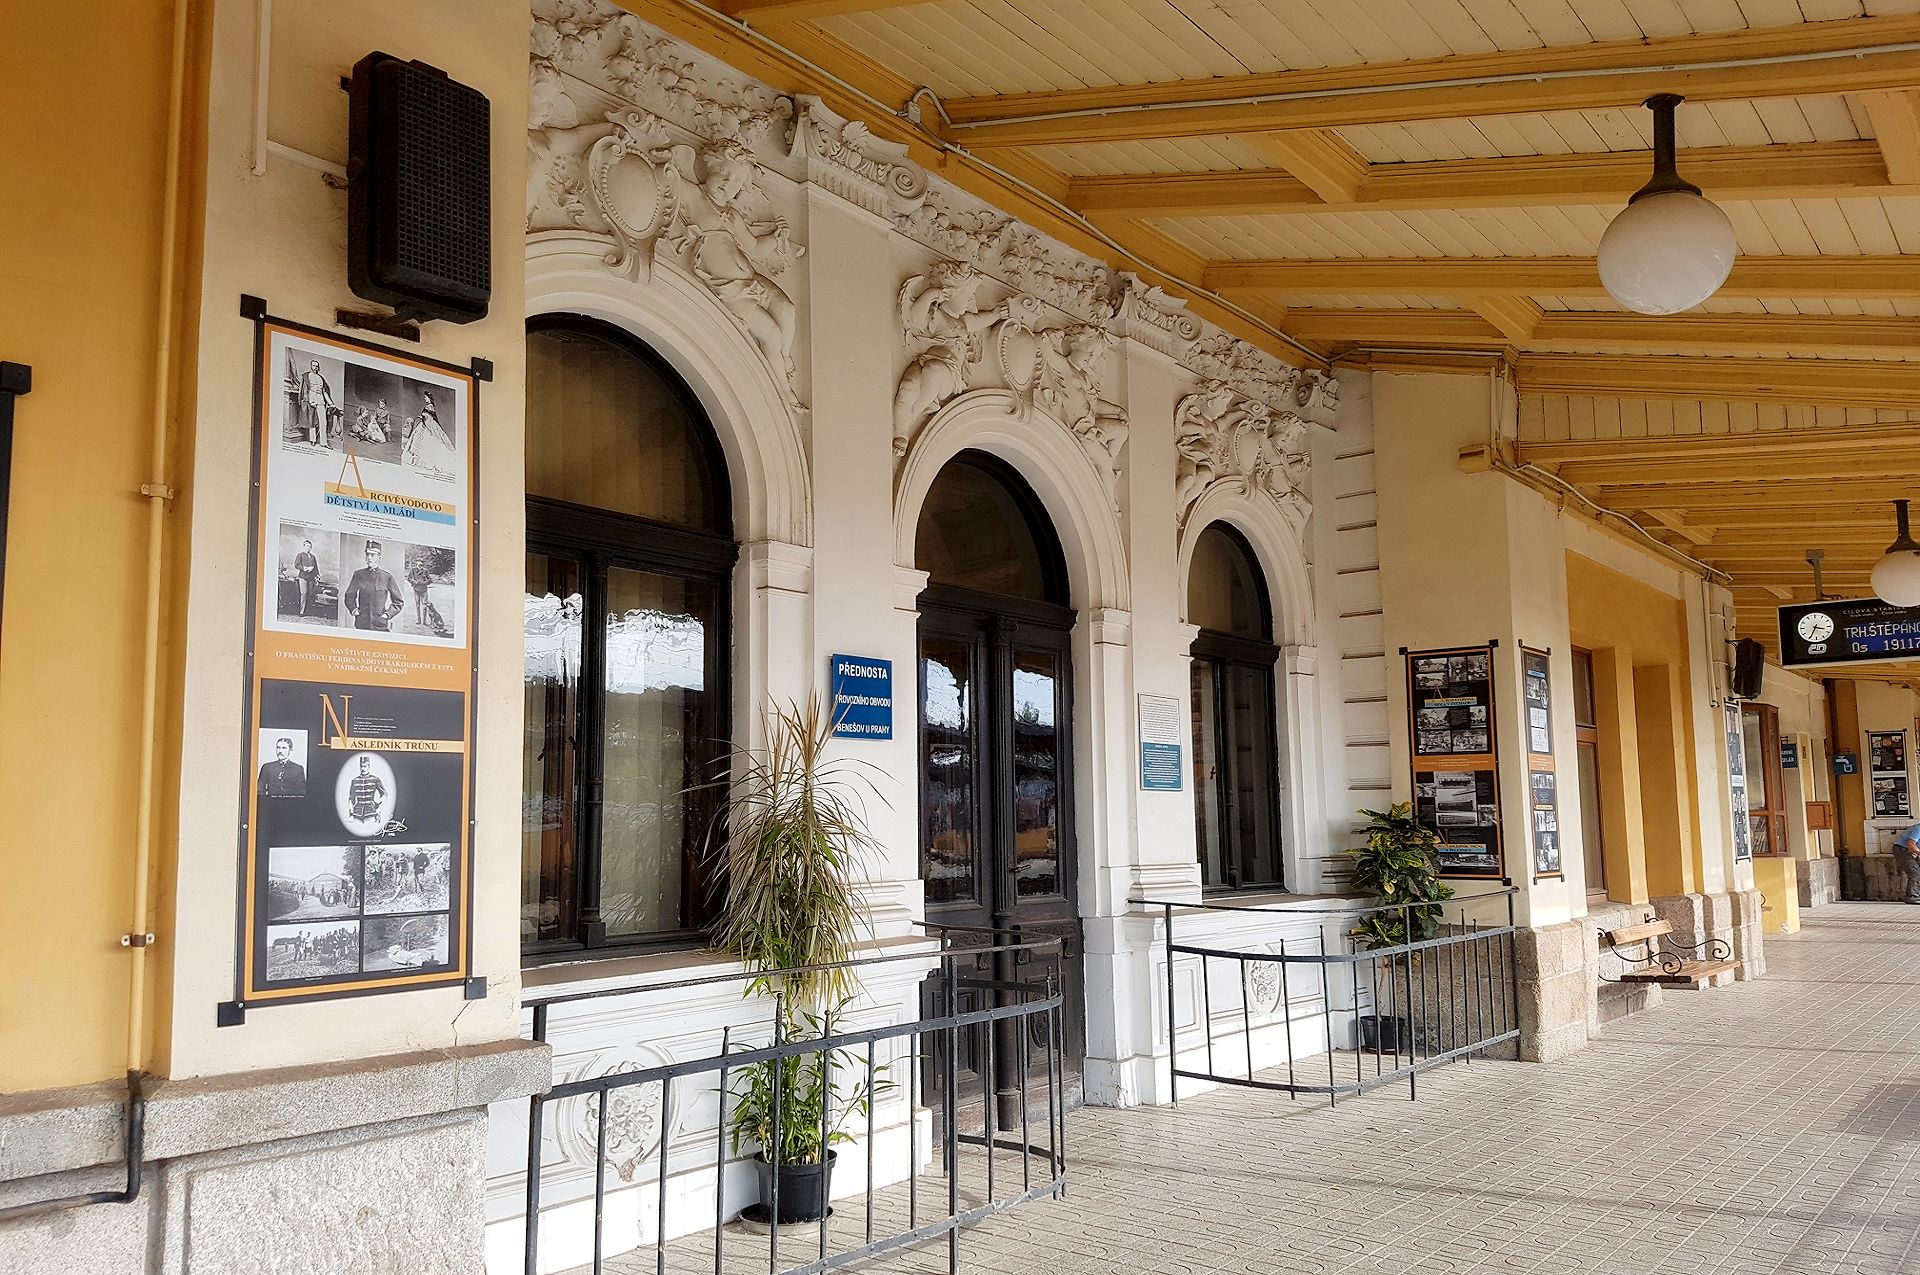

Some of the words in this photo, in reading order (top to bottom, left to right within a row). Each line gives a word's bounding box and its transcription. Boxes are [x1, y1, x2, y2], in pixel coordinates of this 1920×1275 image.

[326, 495, 370, 511] DĚTSTVÍ
[372, 504, 380, 512] A
[382, 505, 416, 519] MLÁDÍ
[282, 652, 327, 663] FRANTIŠKU
[328, 655, 385, 668] FERDINANDOVI
[372, 651, 407, 661] EXPOZICI
[838, 661, 888, 679] PŘEDNOSTA
[869, 697, 891, 708] OBVODU
[837, 722, 865, 733] BENEŠOV
[865, 724, 871, 733] U
[870, 725, 890, 734] PRAHY
